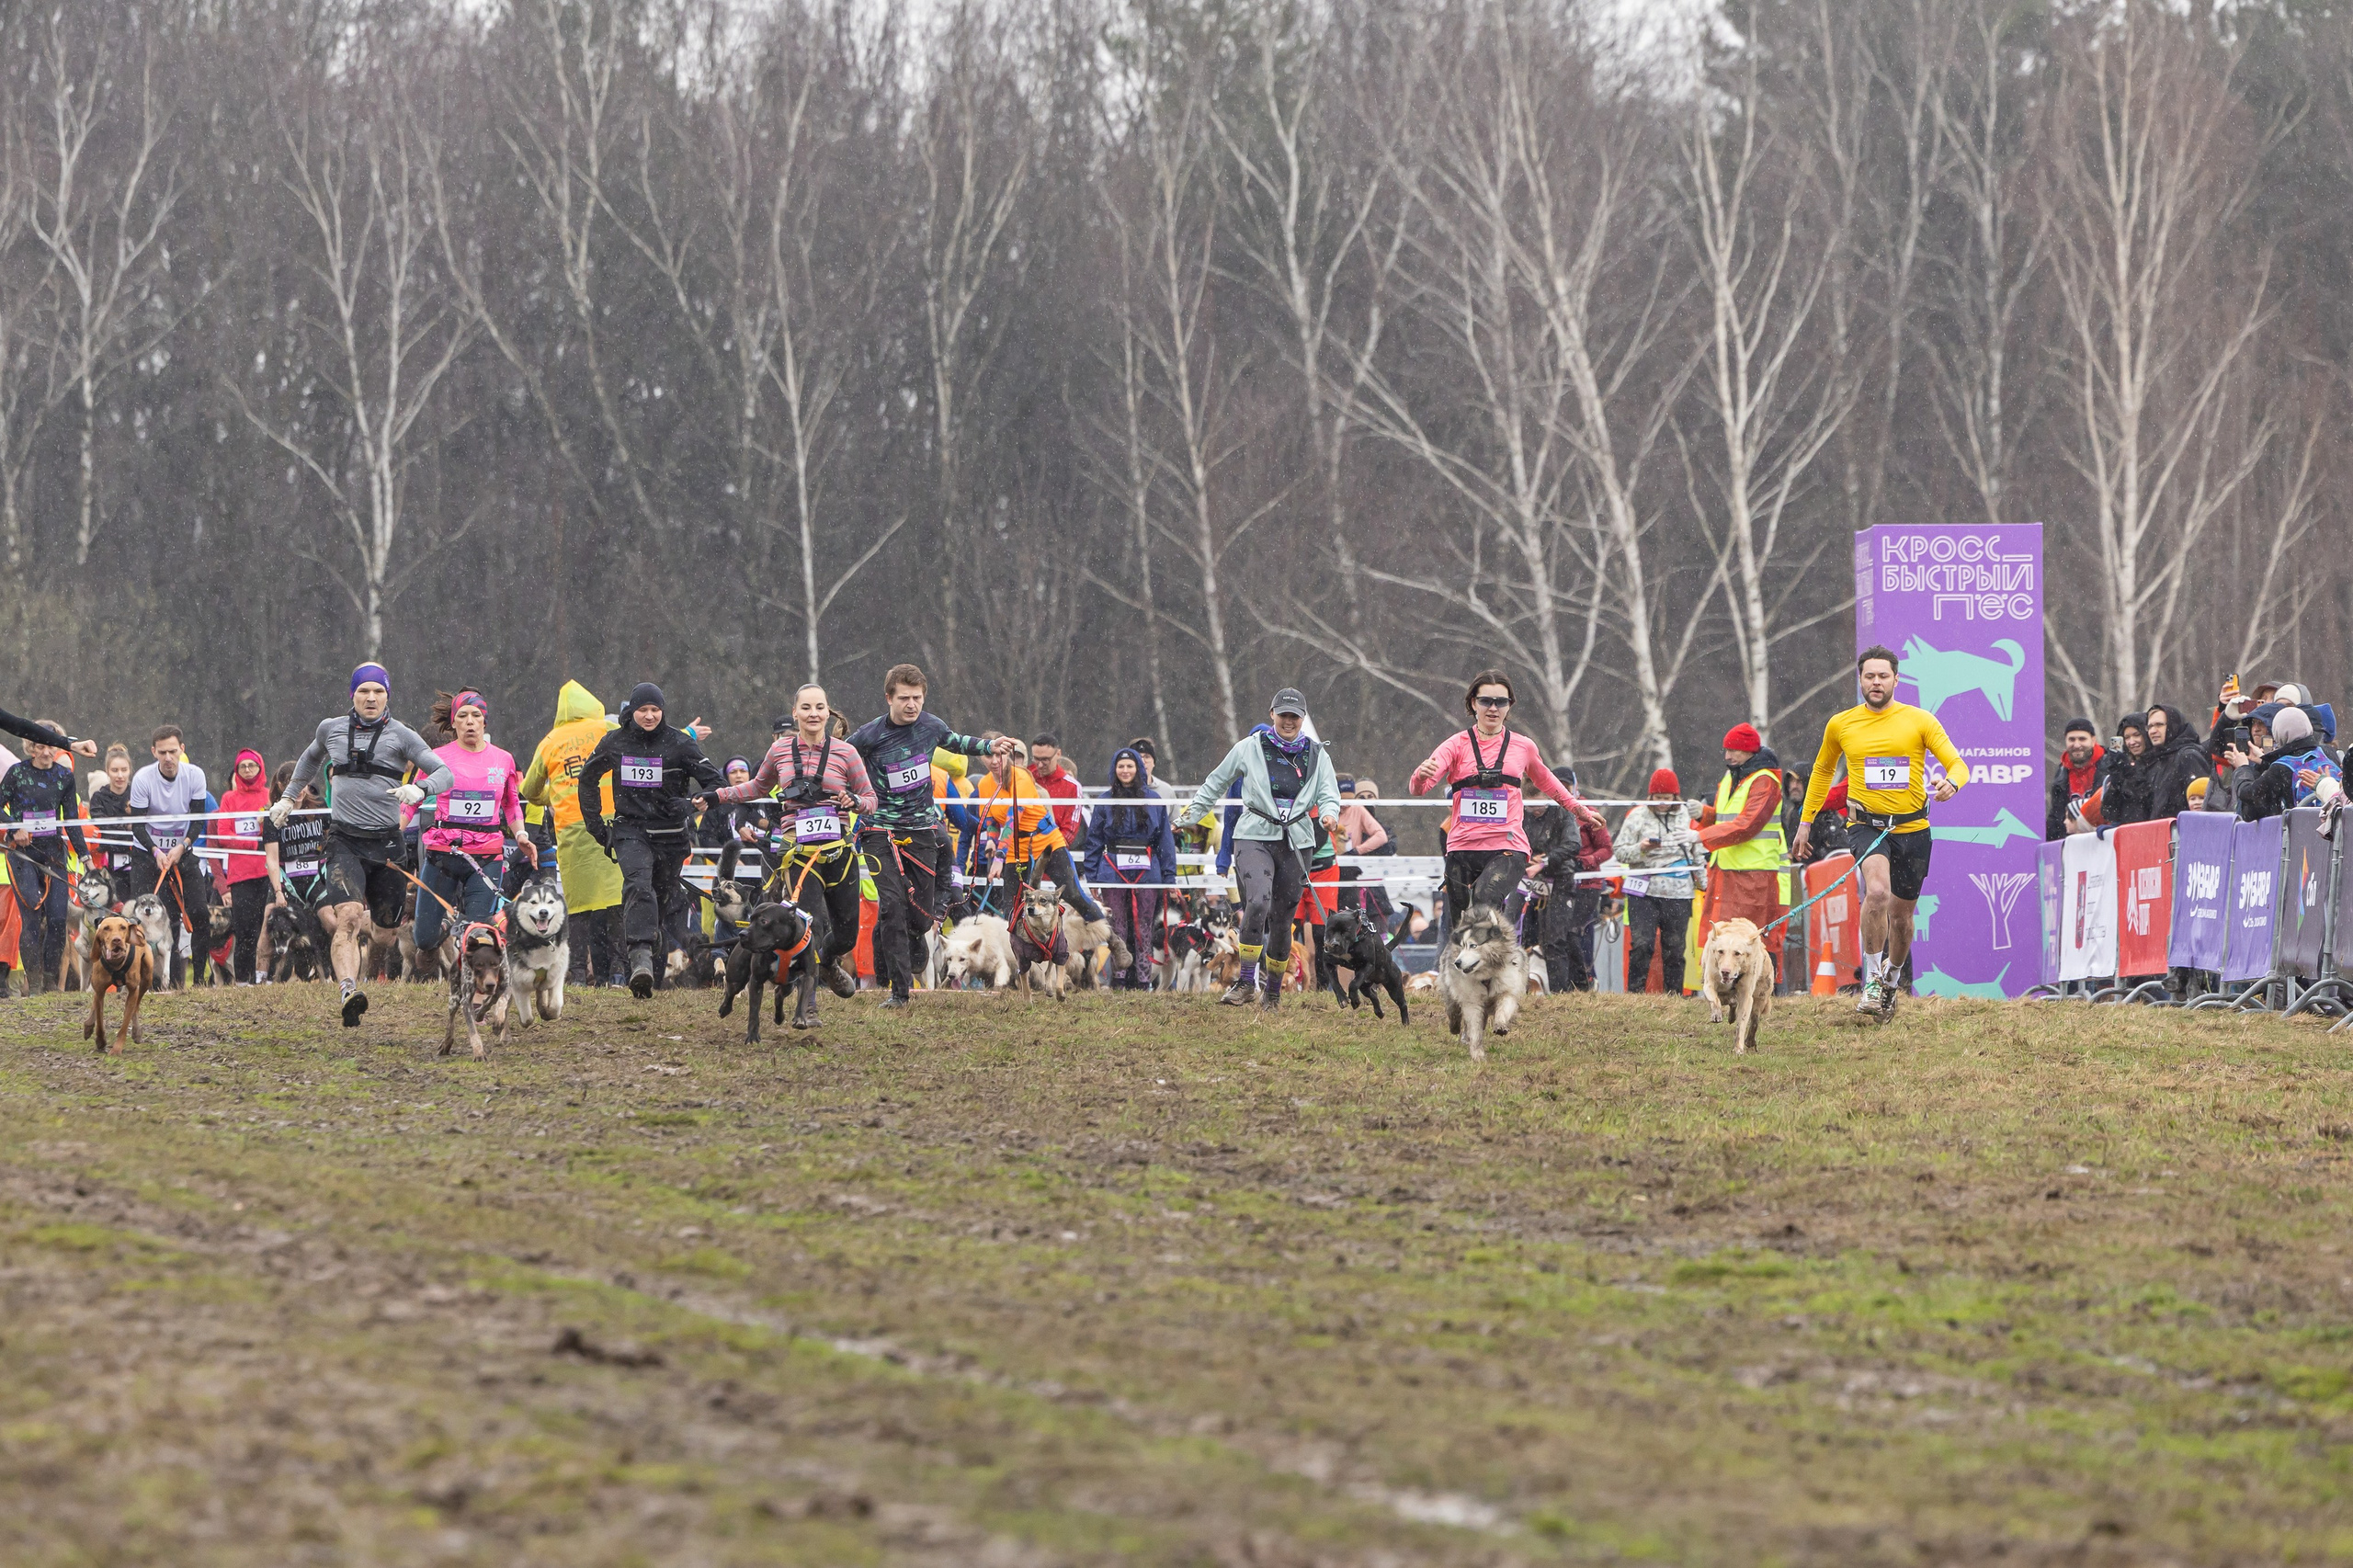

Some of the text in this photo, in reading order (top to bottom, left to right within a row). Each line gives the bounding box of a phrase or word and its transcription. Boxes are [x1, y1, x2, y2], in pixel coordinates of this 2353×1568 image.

[631, 768, 654, 780] 193
[902, 768, 918, 783] 50
[1880, 768, 1896, 781] 19
[464, 802, 482, 815] 92
[1472, 801, 1497, 815] 185
[243, 822, 256, 831] 23
[805, 818, 833, 833] 374
[158, 838, 177, 847] 118
[1128, 856, 1141, 864] 62
[1629, 879, 1643, 890] 119
